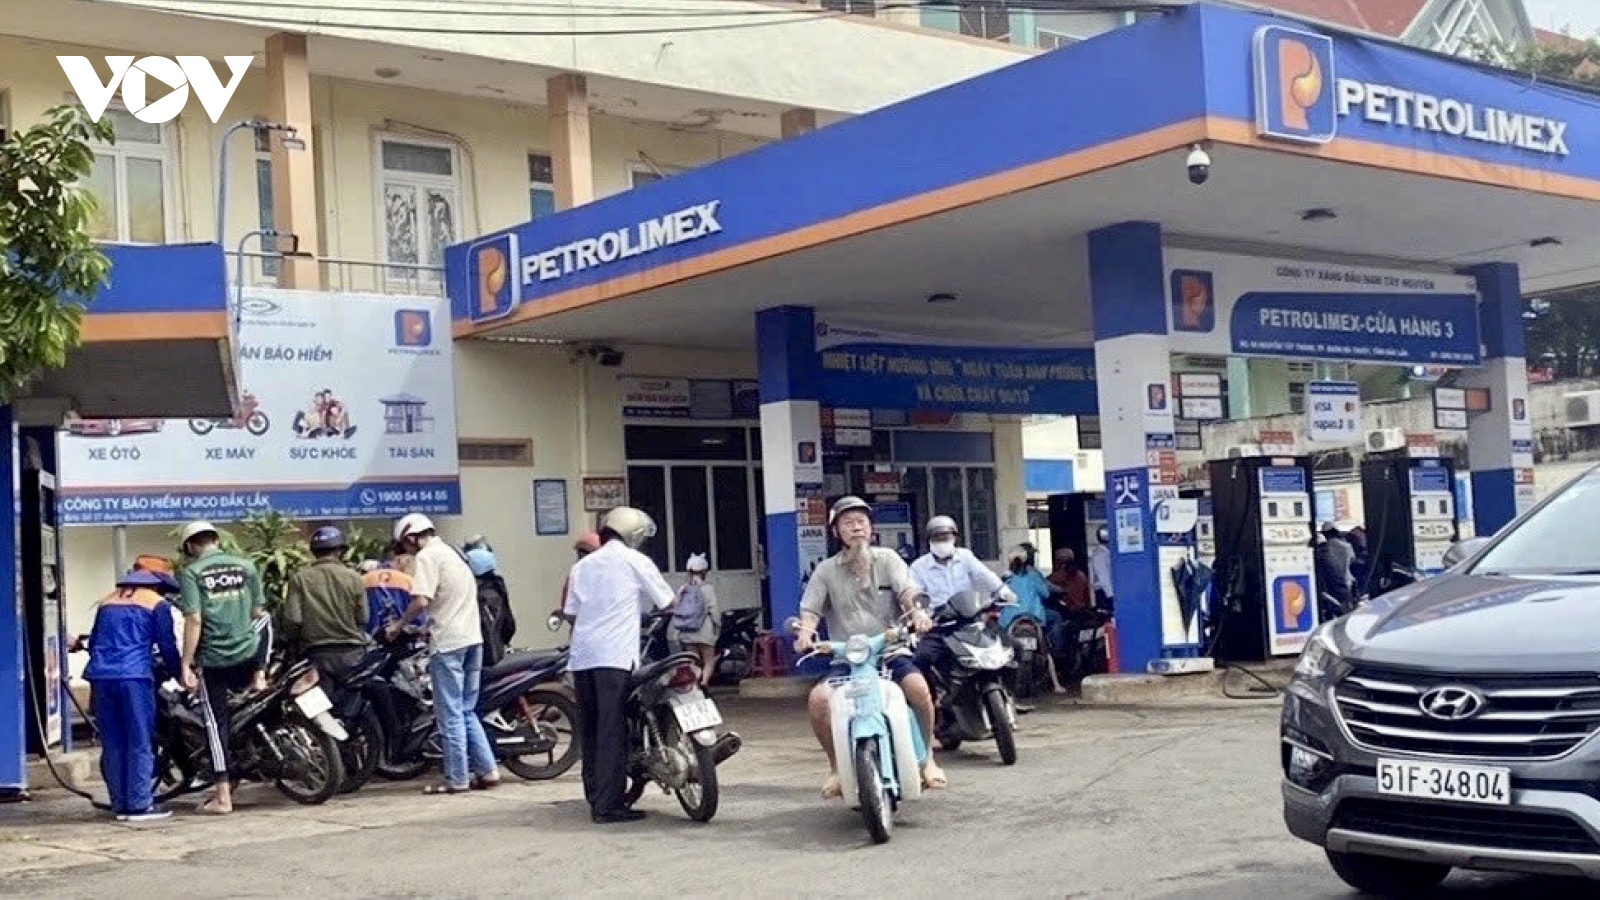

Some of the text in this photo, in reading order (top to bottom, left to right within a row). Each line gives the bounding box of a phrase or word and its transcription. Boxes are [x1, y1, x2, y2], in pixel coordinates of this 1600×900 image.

[1337, 78, 1569, 155] PETROLIMEX
[522, 199, 722, 285] PETROLIMEX
[1400, 315, 1441, 338] HÀNG
[1444, 321, 1454, 339] 3
[239, 342, 260, 360] ÁN
[88, 445, 141, 460] XE ÔTÔ
[205, 446, 255, 460] XE MÁY
[63, 495, 101, 511] CÔNG
[104, 497, 118, 510] TY
[184, 495, 218, 509] PJICO
[1379, 764, 1504, 801] 51F-348.04
